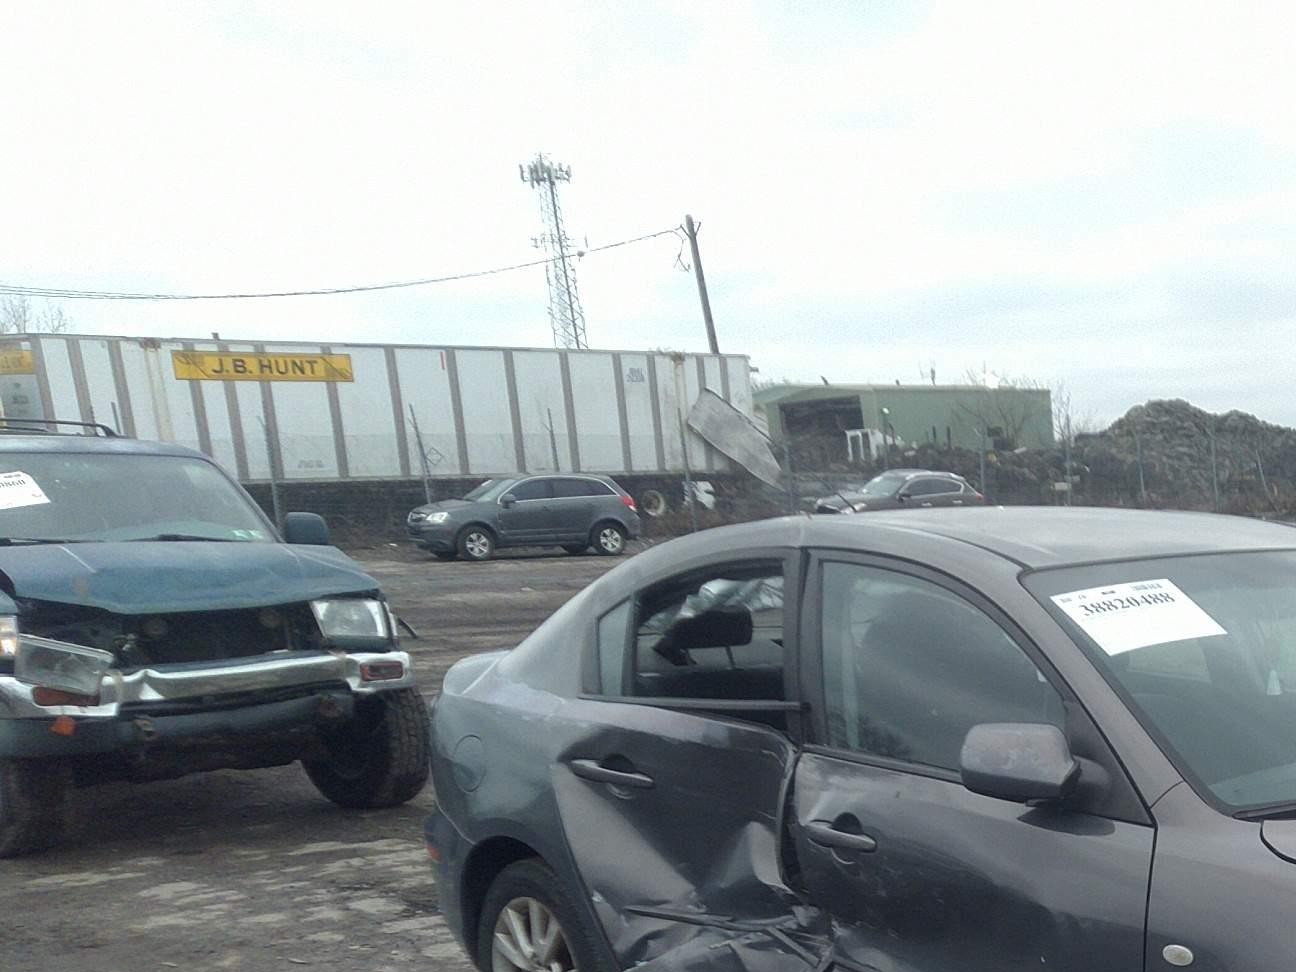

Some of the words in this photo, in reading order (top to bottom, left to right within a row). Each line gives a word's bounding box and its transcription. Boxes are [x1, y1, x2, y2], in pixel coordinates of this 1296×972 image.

[212, 358, 253, 375] J.B.
[258, 359, 318, 375] HUNT
[1080, 593, 1175, 616] 38820488
